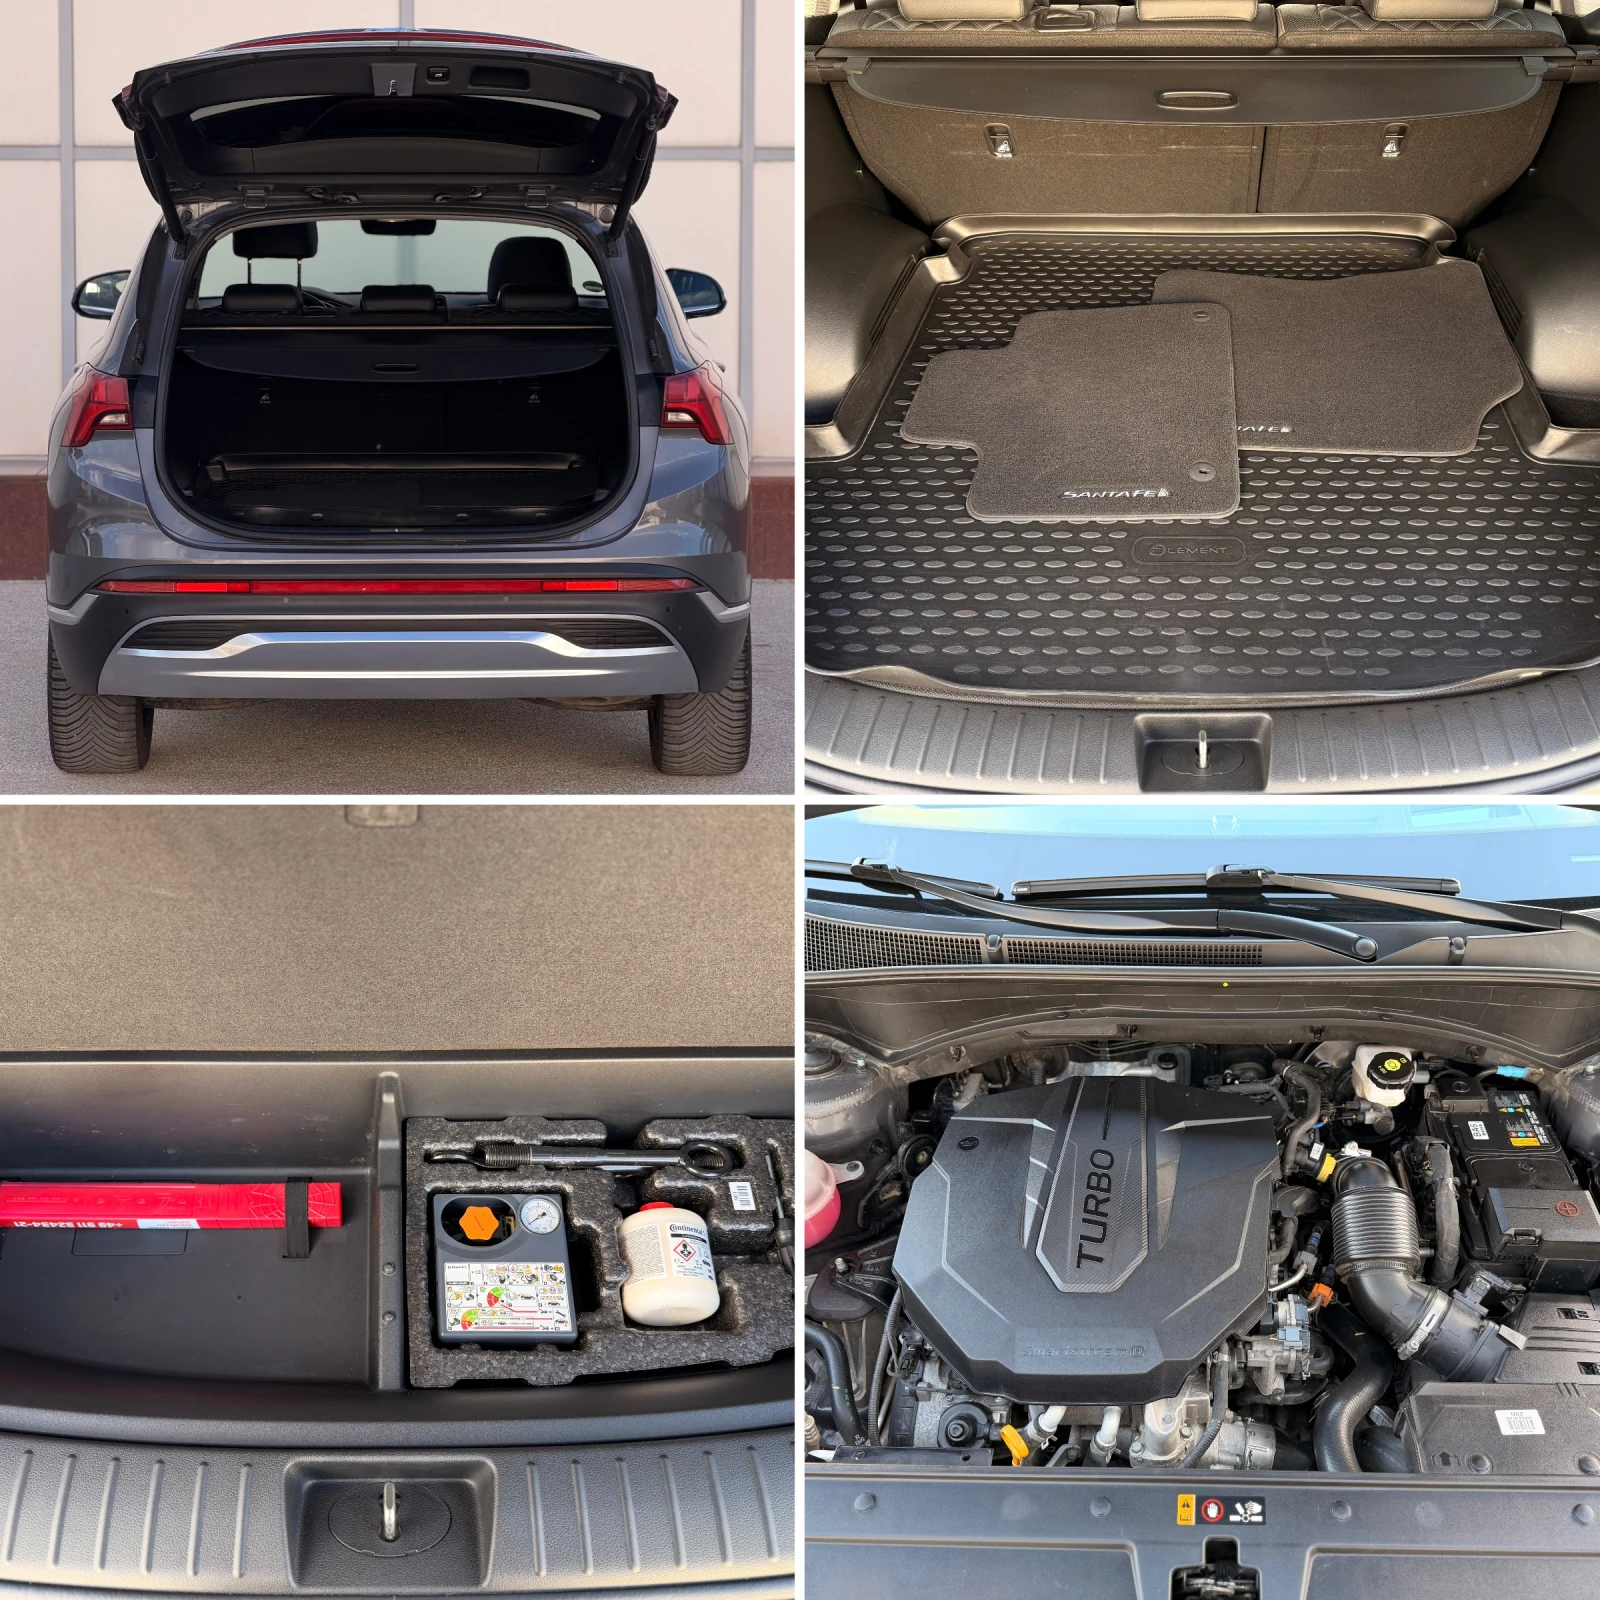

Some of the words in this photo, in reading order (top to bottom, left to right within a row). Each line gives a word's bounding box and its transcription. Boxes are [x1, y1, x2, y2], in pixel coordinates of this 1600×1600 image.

[1076, 1148, 1115, 1269] TURBO
[77, 1221, 96, 1229] 911
[97, 1221, 123, 1229] +49
[669, 1223, 704, 1235] Continental
